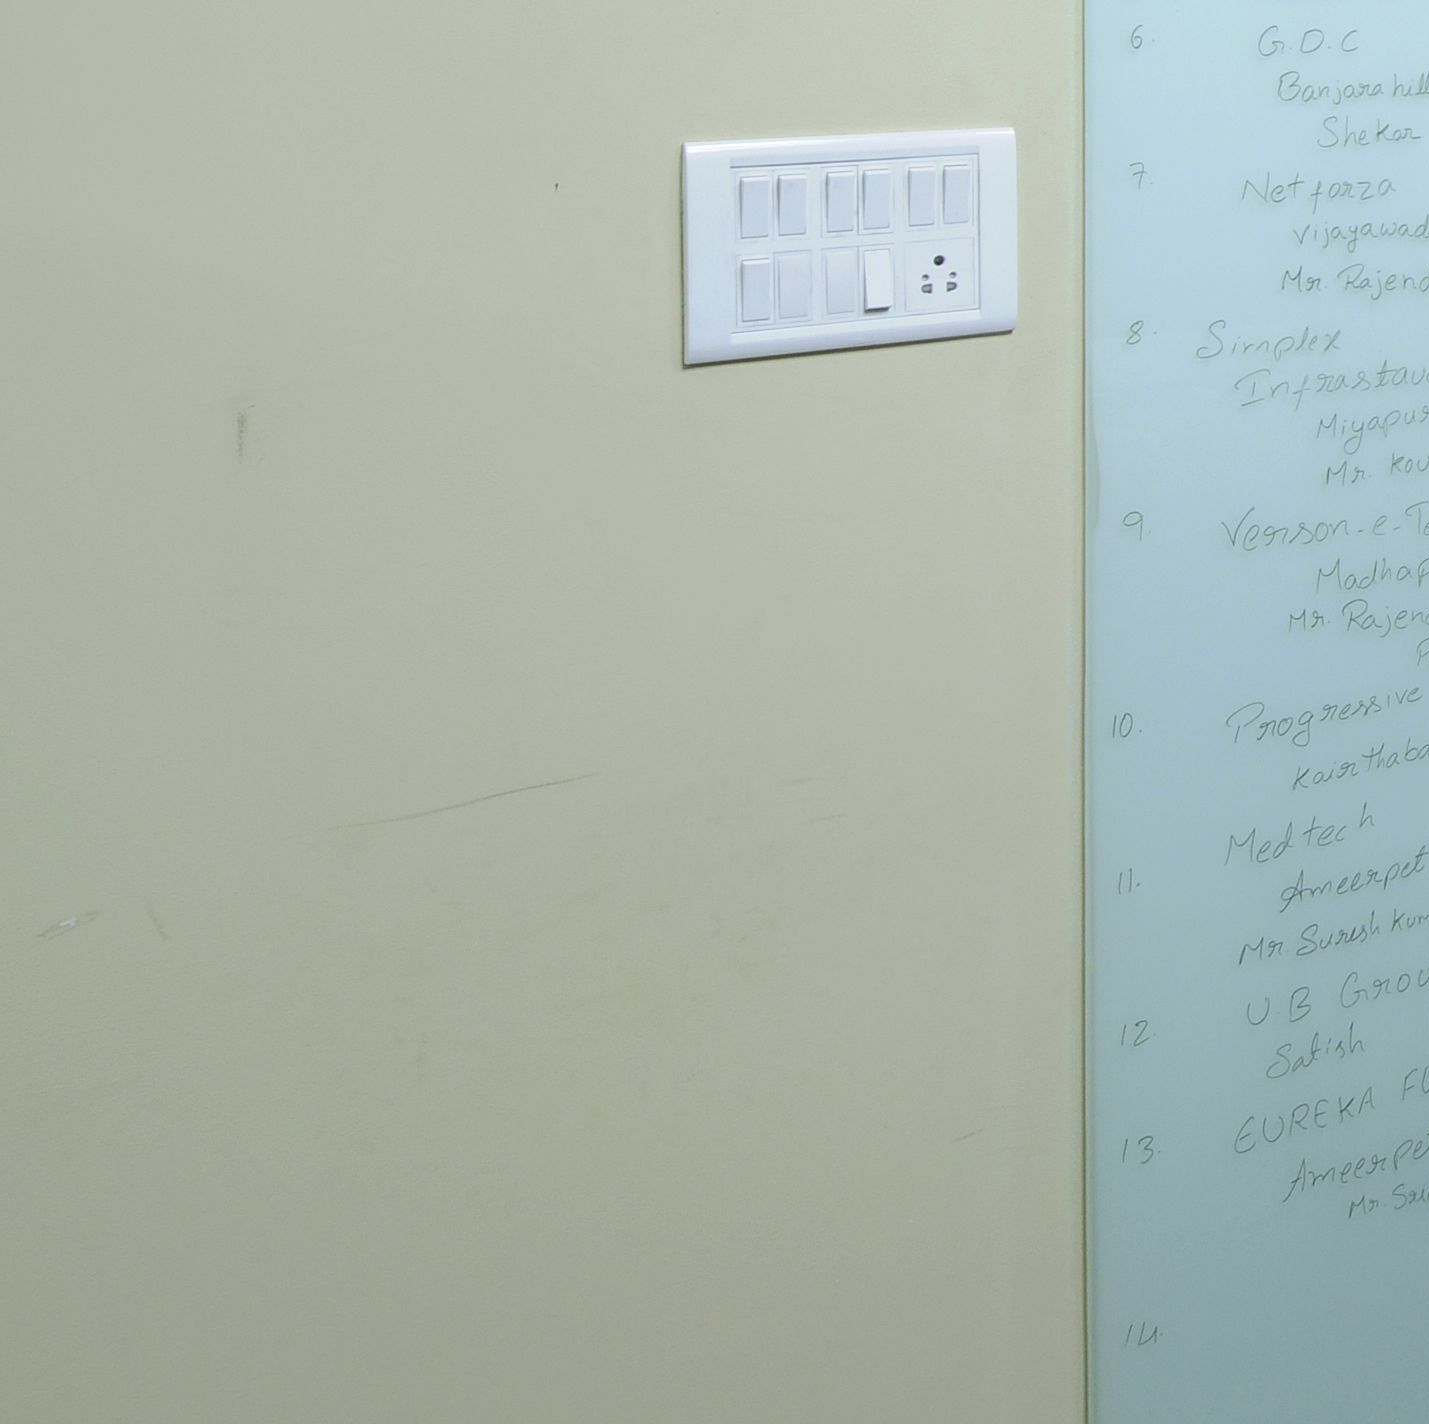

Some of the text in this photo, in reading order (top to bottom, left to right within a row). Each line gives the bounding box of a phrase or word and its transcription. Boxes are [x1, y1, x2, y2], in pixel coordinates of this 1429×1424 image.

[1195, 318, 1342, 362] Simplex
[1225, 686, 1423, 748] Progressive
[1234, 1085, 1375, 1154] EUREKA
